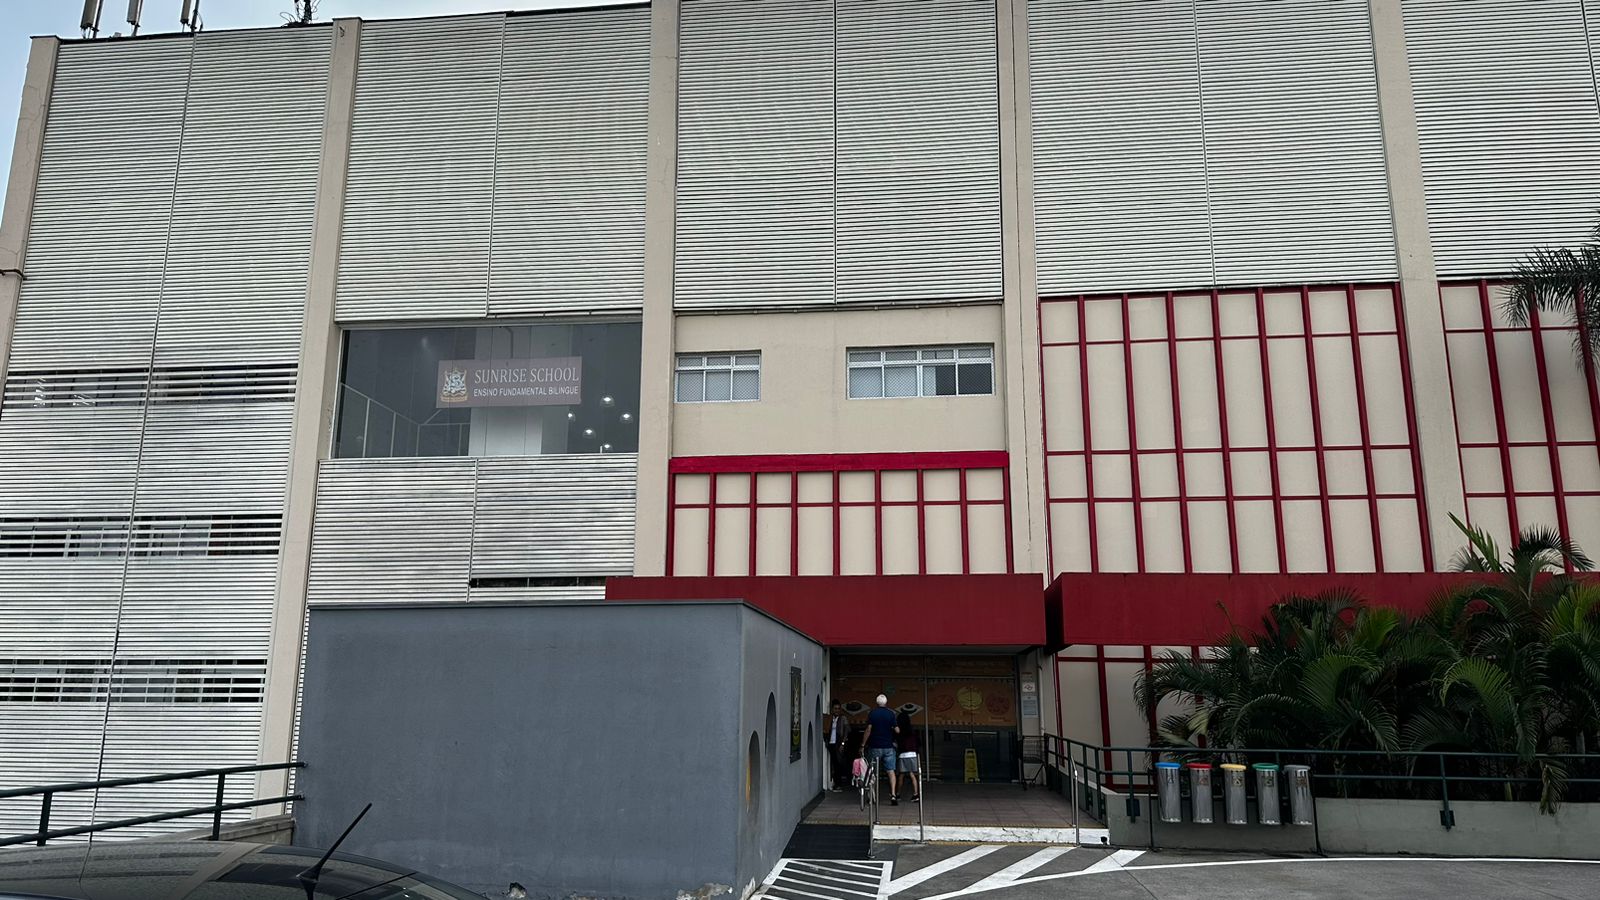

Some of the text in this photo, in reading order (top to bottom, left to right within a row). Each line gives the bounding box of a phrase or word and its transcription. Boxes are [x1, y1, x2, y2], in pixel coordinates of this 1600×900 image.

[474, 367, 579, 384] SUNRISE SCHOOL
[473, 387, 498, 397] ENSINO
[499, 387, 547, 396] FUNDAMENTAL
